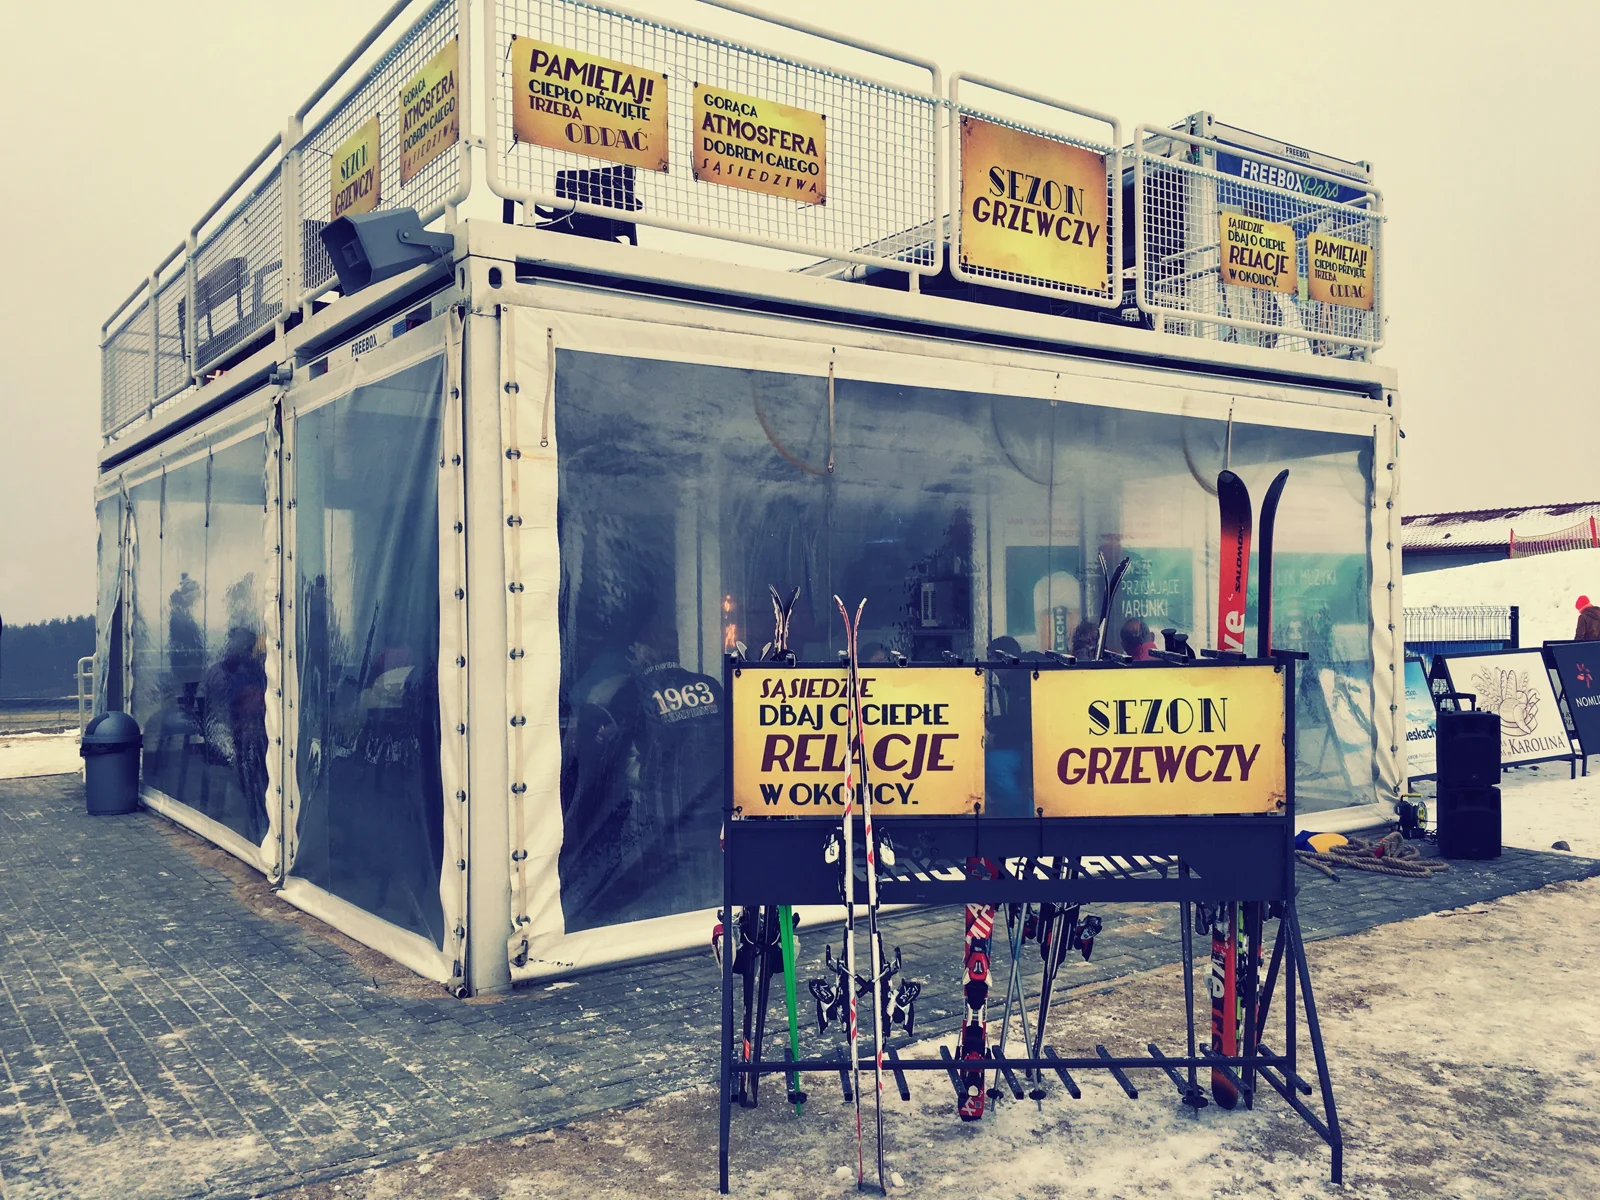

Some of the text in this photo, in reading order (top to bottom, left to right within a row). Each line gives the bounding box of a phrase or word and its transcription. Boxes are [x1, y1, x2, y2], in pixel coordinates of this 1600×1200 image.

[403, 78, 426, 107] GORĄCA
[529, 49, 654, 105] PAMIĘTAJ!
[403, 70, 454, 134] ATMOSFERA
[529, 79, 650, 121] CIEPŁO PRZYJĘTE
[529, 95, 582, 121] TRZEBA
[704, 93, 758, 118] GORĄCA
[403, 122, 430, 153] DOBREM
[565, 122, 648, 151] ODDAĆ
[701, 112, 818, 157] ATMOSFERA
[703, 137, 820, 176] DOBREM CAŁEGO
[335, 166, 375, 216] GRZEWCZY
[701, 158, 818, 194] SĄSIEDZTWA
[988, 165, 1084, 217] SEZON
[1241, 159, 1304, 192] FREEBOX
[973, 196, 1101, 248] GRZEWCZY
[1228, 230, 1250, 247] DBAJ
[1250, 234, 1258, 246] O
[1314, 239, 1367, 266] PAMIĘTAJ!
[1229, 245, 1289, 276] RELACJE
[1229, 268, 1237, 280] W
[1314, 269, 1337, 282] TRZEBA
[351, 333, 378, 357] FREEBOX
[1235, 526, 1244, 594] SALOMON
[1056, 615, 1065, 651] LECH
[652, 682, 714, 714] 1963
[760, 677, 876, 703] SĄSIEDZIE
[1575, 694, 1600, 708] NOMLI
[759, 703, 949, 731] DBAJ O CIEPŁE
[1088, 697, 1228, 736] SEZON
[760, 732, 959, 780] RELACJE
[1056, 743, 1262, 785] GRZEWCZY
[759, 782, 786, 806] W
